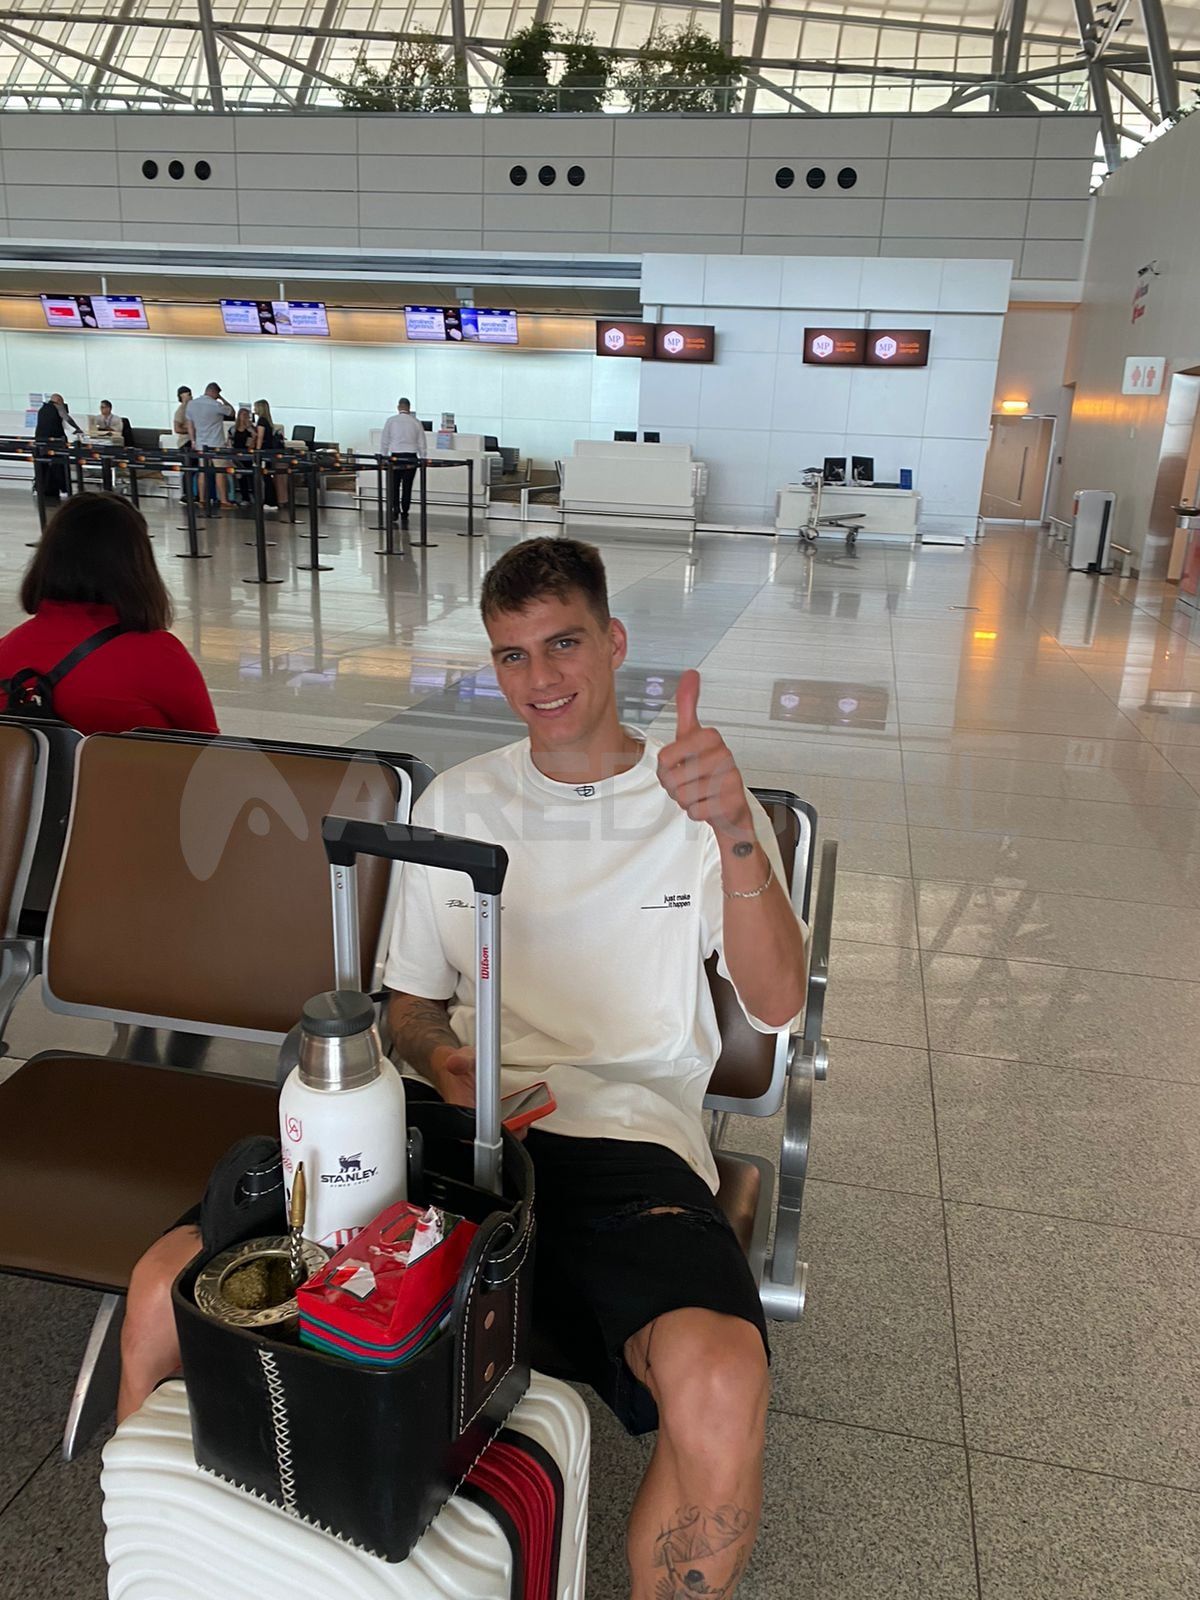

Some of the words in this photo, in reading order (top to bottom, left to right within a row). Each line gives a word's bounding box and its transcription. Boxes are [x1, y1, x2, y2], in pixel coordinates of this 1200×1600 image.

[607, 335, 621, 344] MP
[667, 338, 681, 347] MP
[816, 342, 830, 350] MP
[879, 343, 893, 352] MP
[663, 893, 676, 904] just
[676, 893, 691, 901] make
[481, 946, 490, 980] Wilson
[320, 1166, 378, 1184] STANLEY
